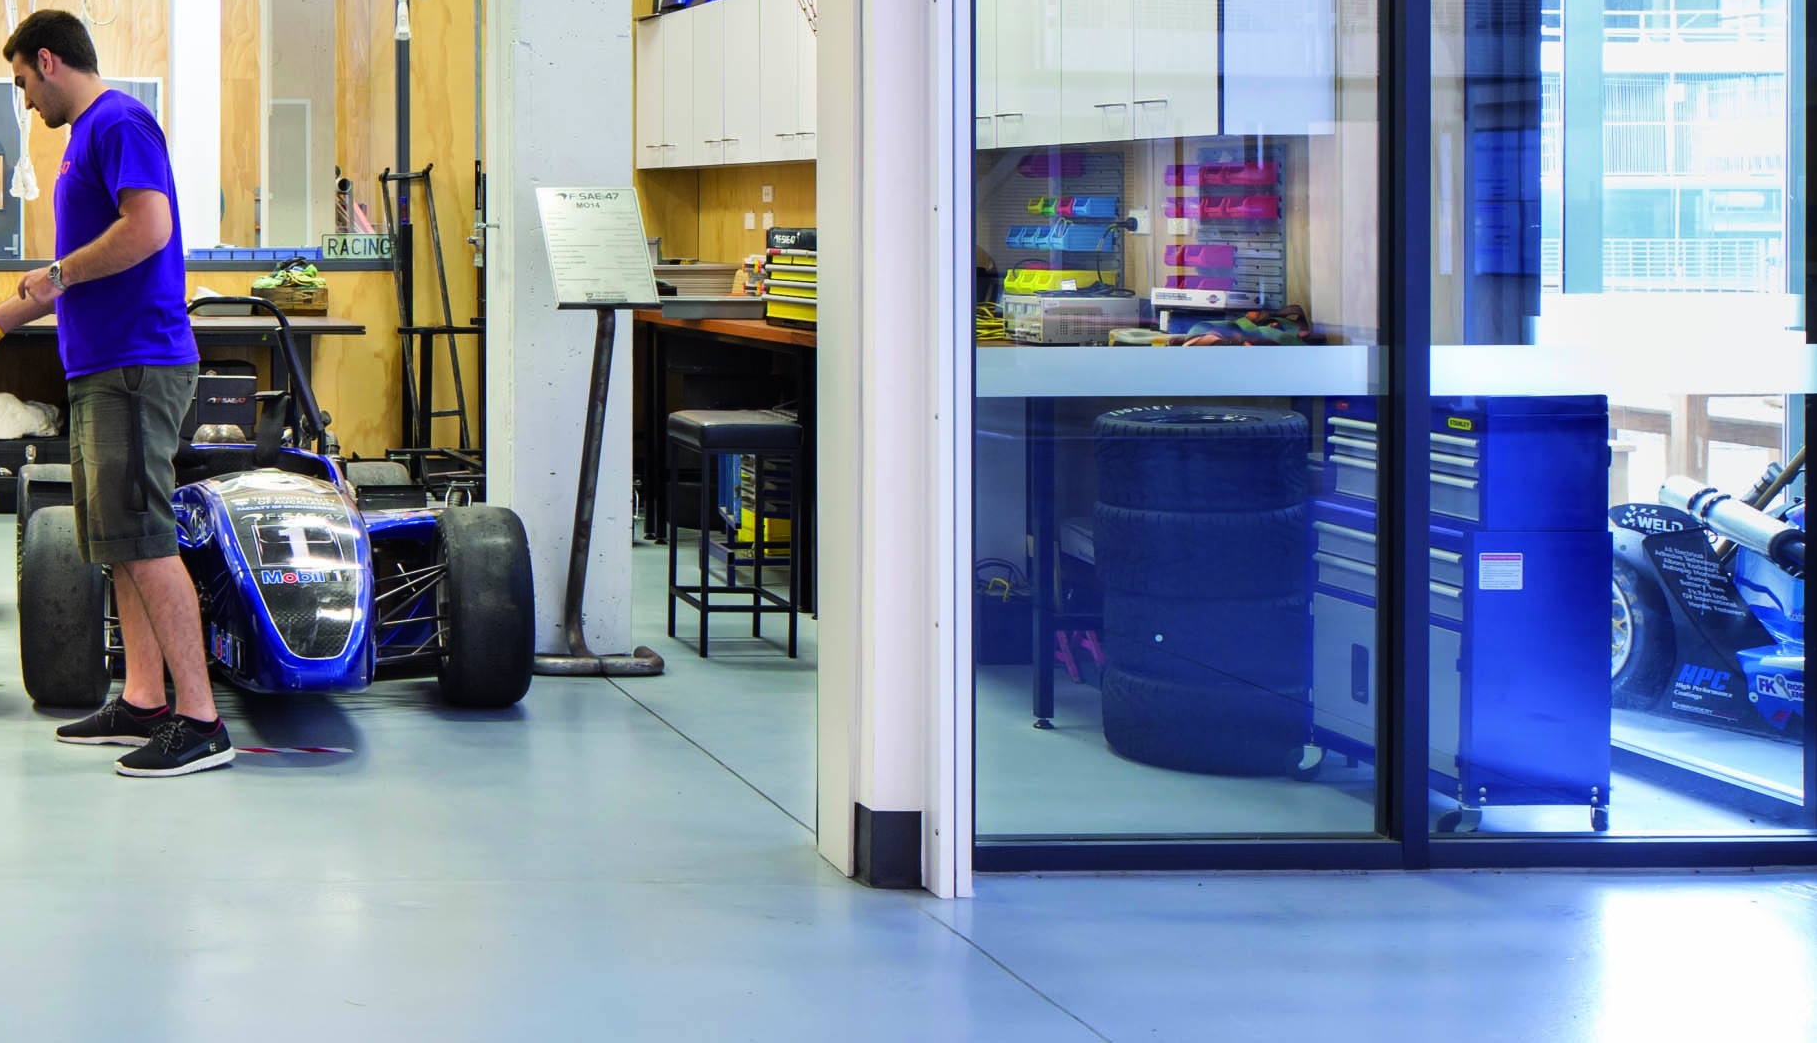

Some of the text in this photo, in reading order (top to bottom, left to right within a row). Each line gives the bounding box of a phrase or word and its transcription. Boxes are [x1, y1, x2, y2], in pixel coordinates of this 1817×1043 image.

[327, 238, 391, 256] RACING
[1637, 515, 1683, 532] WELD
[261, 570, 326, 585] Mobil
[1678, 662, 1732, 692] HPC
[1758, 675, 1776, 694] FK
